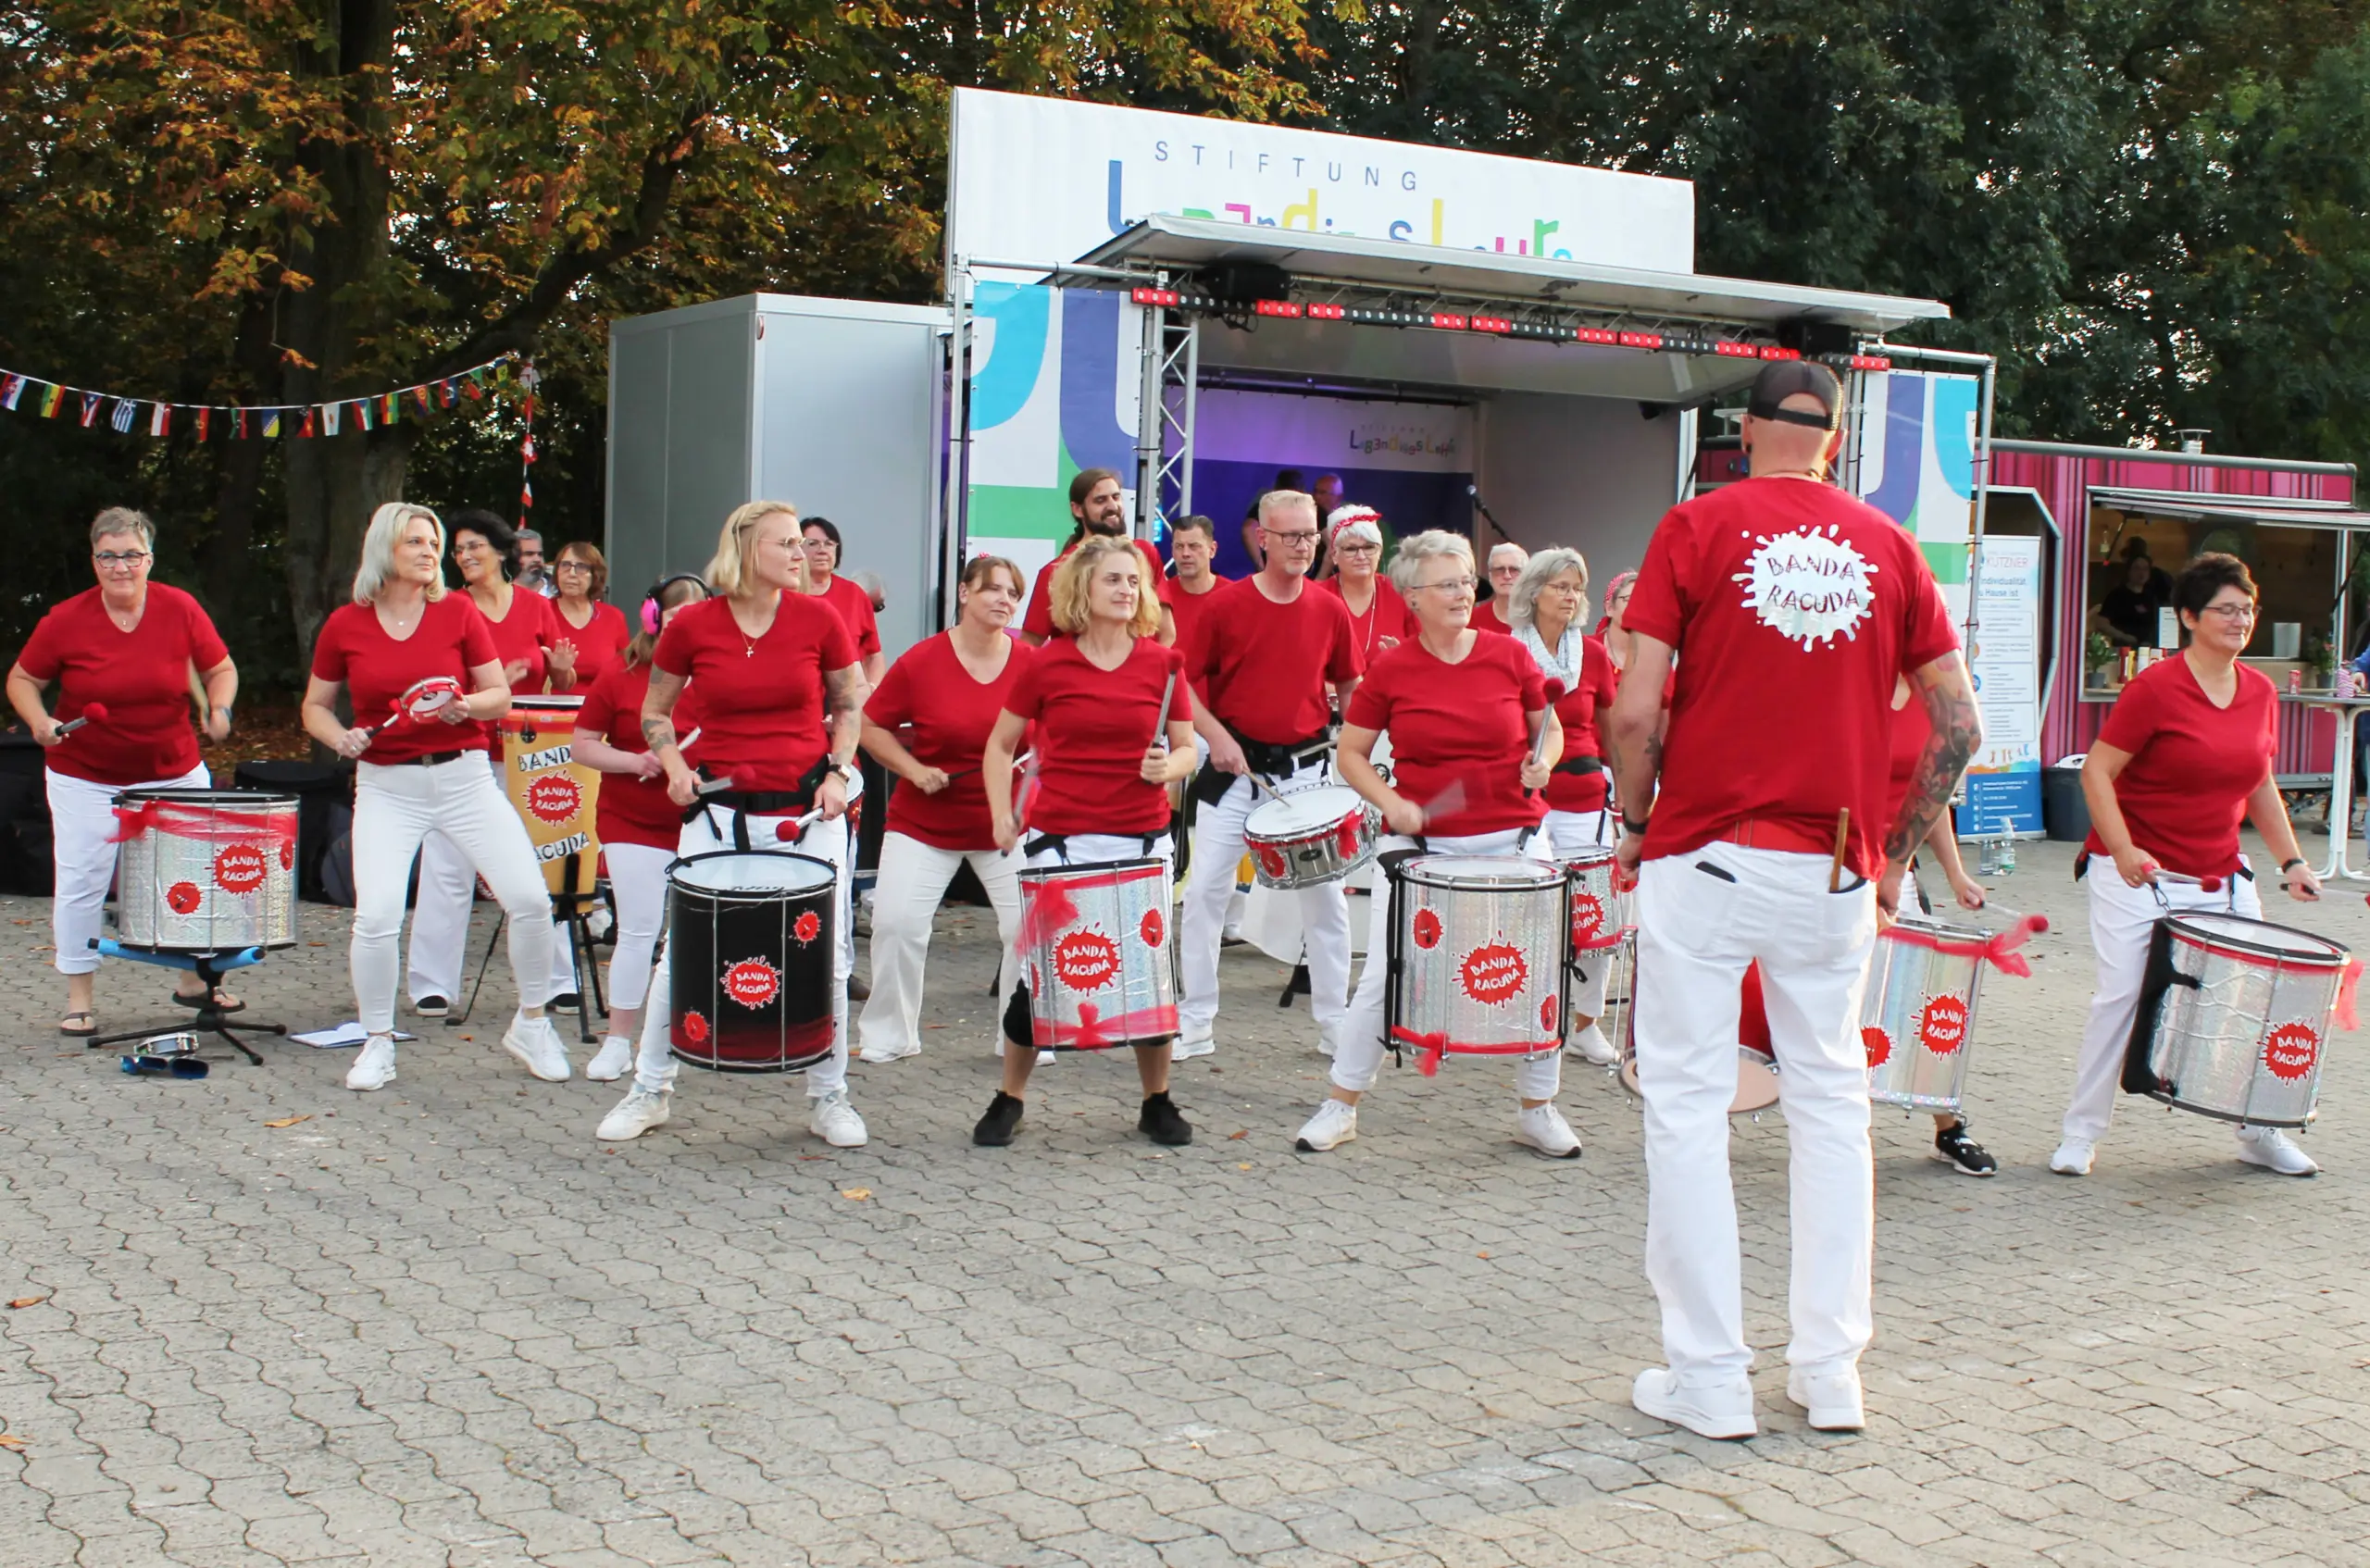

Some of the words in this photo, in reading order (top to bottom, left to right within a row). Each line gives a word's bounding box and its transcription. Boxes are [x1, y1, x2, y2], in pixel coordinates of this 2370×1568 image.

[1155, 141, 1416, 192] STIFTUNG
[1767, 554, 1855, 581] BANDA
[1766, 585, 1859, 613] RACUDA
[518, 746, 571, 772] BAND
[536, 787, 574, 798] BANDA
[535, 798, 575, 811] RACUDA
[533, 832, 590, 862] ACUDA
[221, 855, 261, 868] BANDA
[1063, 944, 1109, 960] BANDA
[1063, 959, 1111, 976] RACUDA
[1469, 955, 1517, 976] BANDA
[735, 972, 771, 982] BANDA
[1473, 968, 1521, 990] RACUDA
[1930, 1009, 1963, 1024] BANDA
[2276, 1036, 2312, 1051] BANDA
